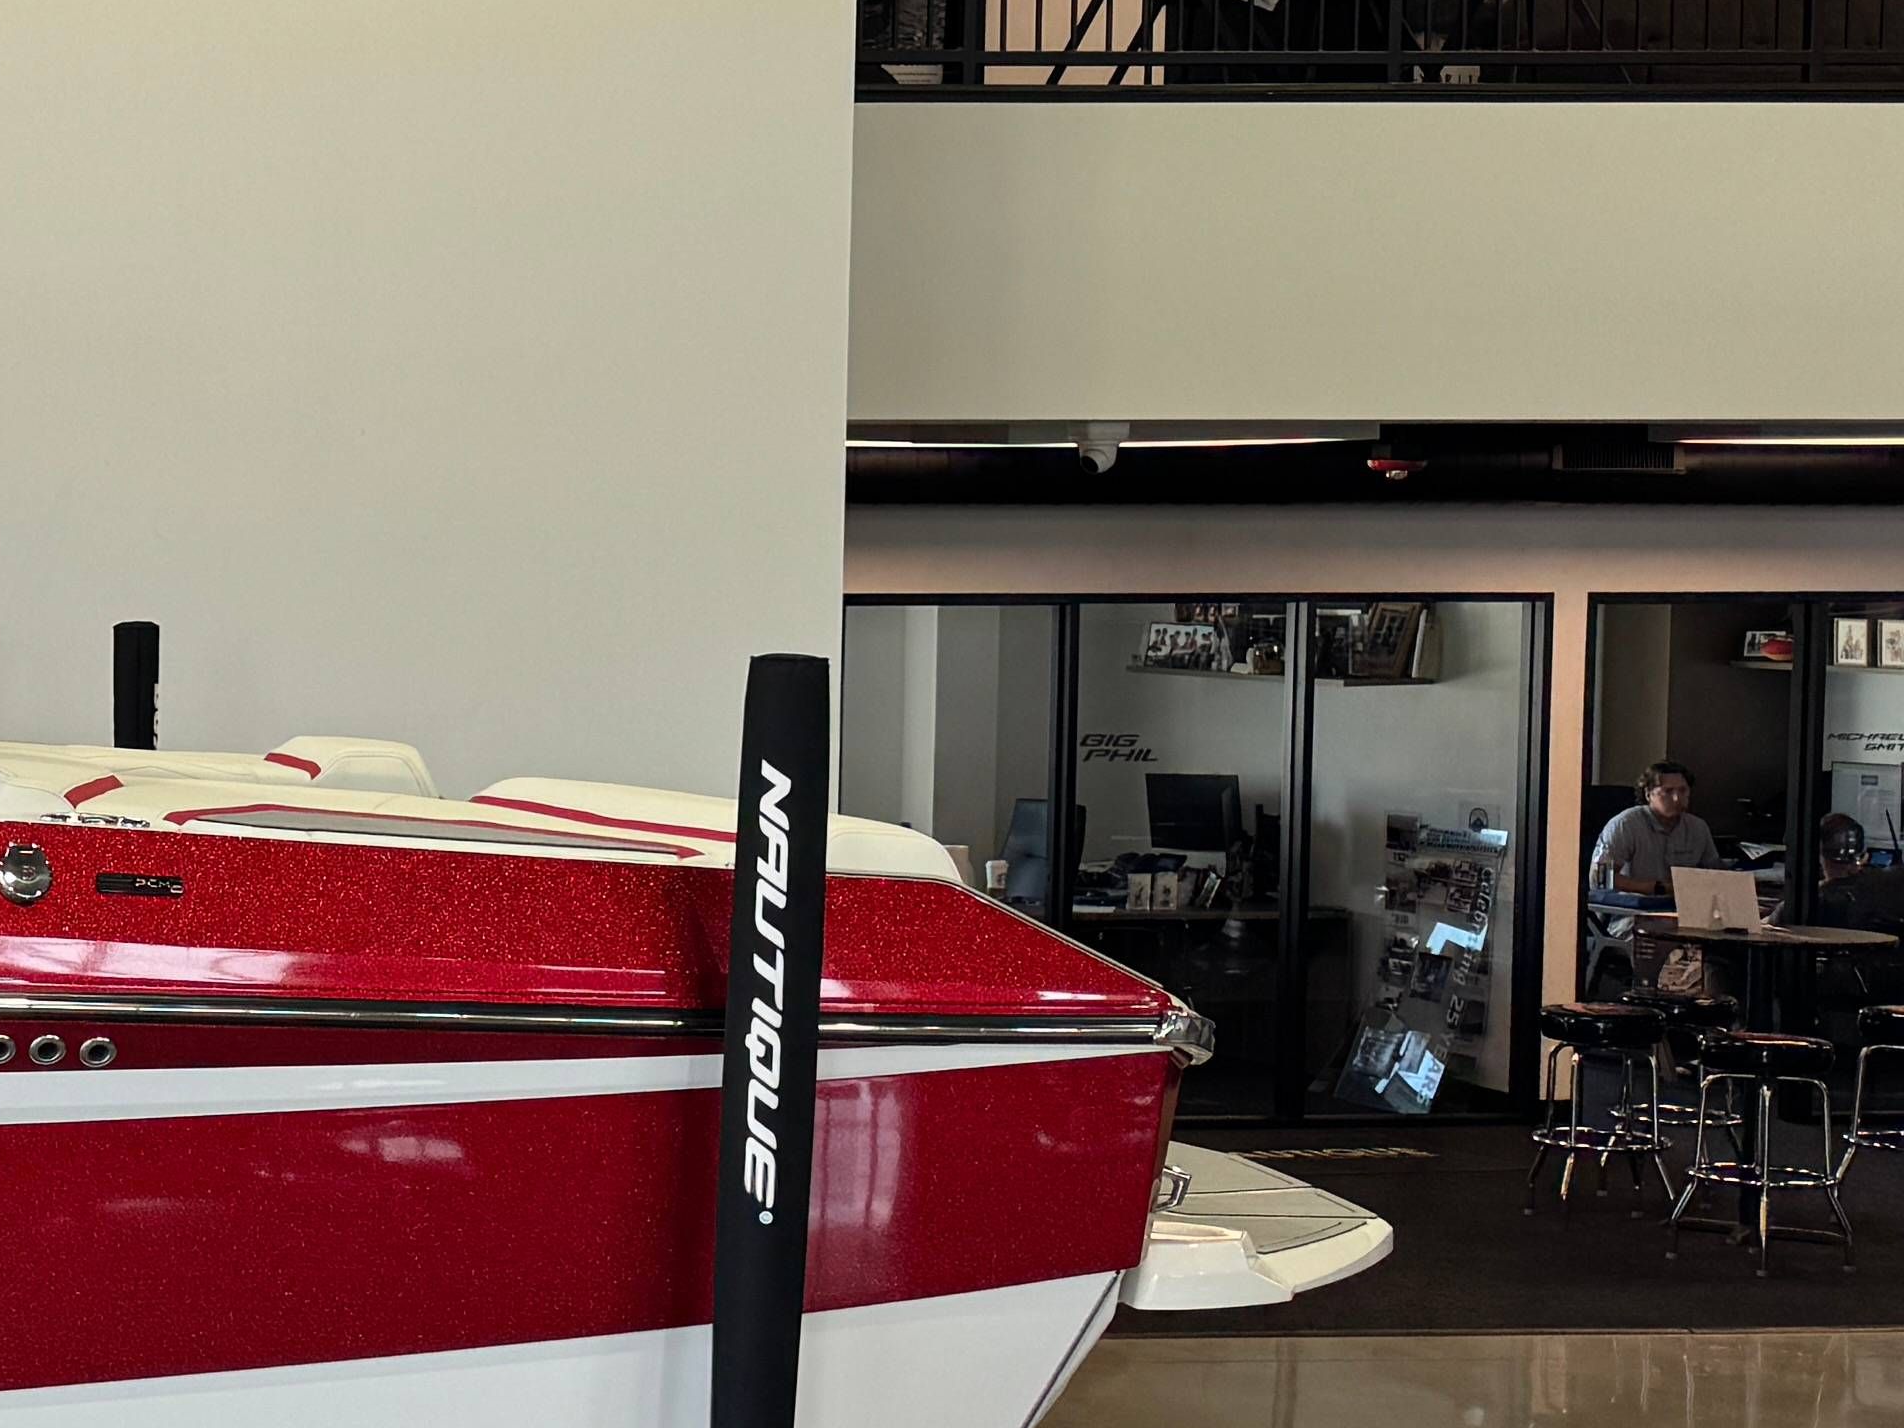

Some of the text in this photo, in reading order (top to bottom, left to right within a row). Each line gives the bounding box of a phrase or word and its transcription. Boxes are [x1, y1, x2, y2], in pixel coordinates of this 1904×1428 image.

[1079, 733, 1140, 747] BIG
[1082, 748, 1159, 762] PHIL
[743, 759, 792, 1210] NAUTIQUE
